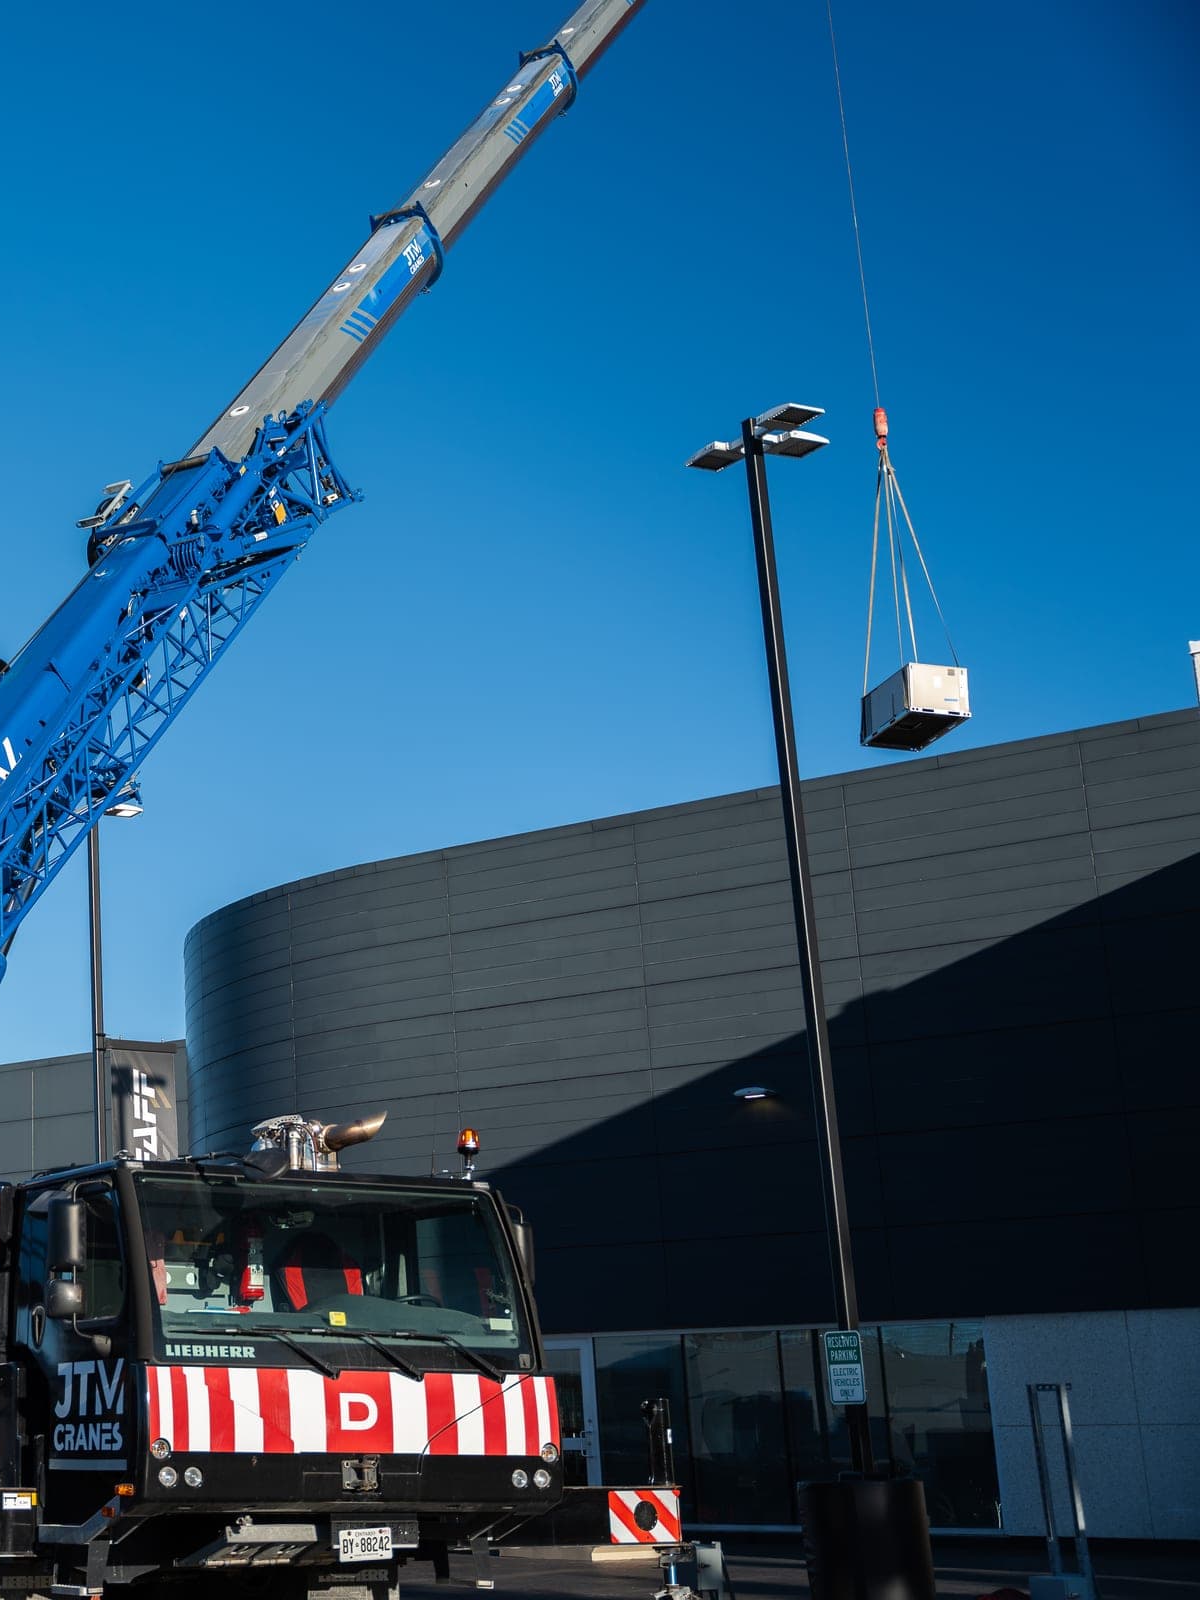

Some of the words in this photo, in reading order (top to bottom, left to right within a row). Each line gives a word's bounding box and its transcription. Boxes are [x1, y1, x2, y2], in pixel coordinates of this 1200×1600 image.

[827, 1335, 858, 1348] RESERVED
[165, 1343, 256, 1359] LIEBHERR
[830, 1349, 858, 1361] PARKING
[832, 1367, 858, 1377] ELECTRIC
[54, 1357, 125, 1419] JTM
[834, 1378, 861, 1387] VEHICLES
[840, 1389, 855, 1398] ONLY
[339, 1392, 379, 1431] D
[53, 1422, 123, 1452] CRANES
